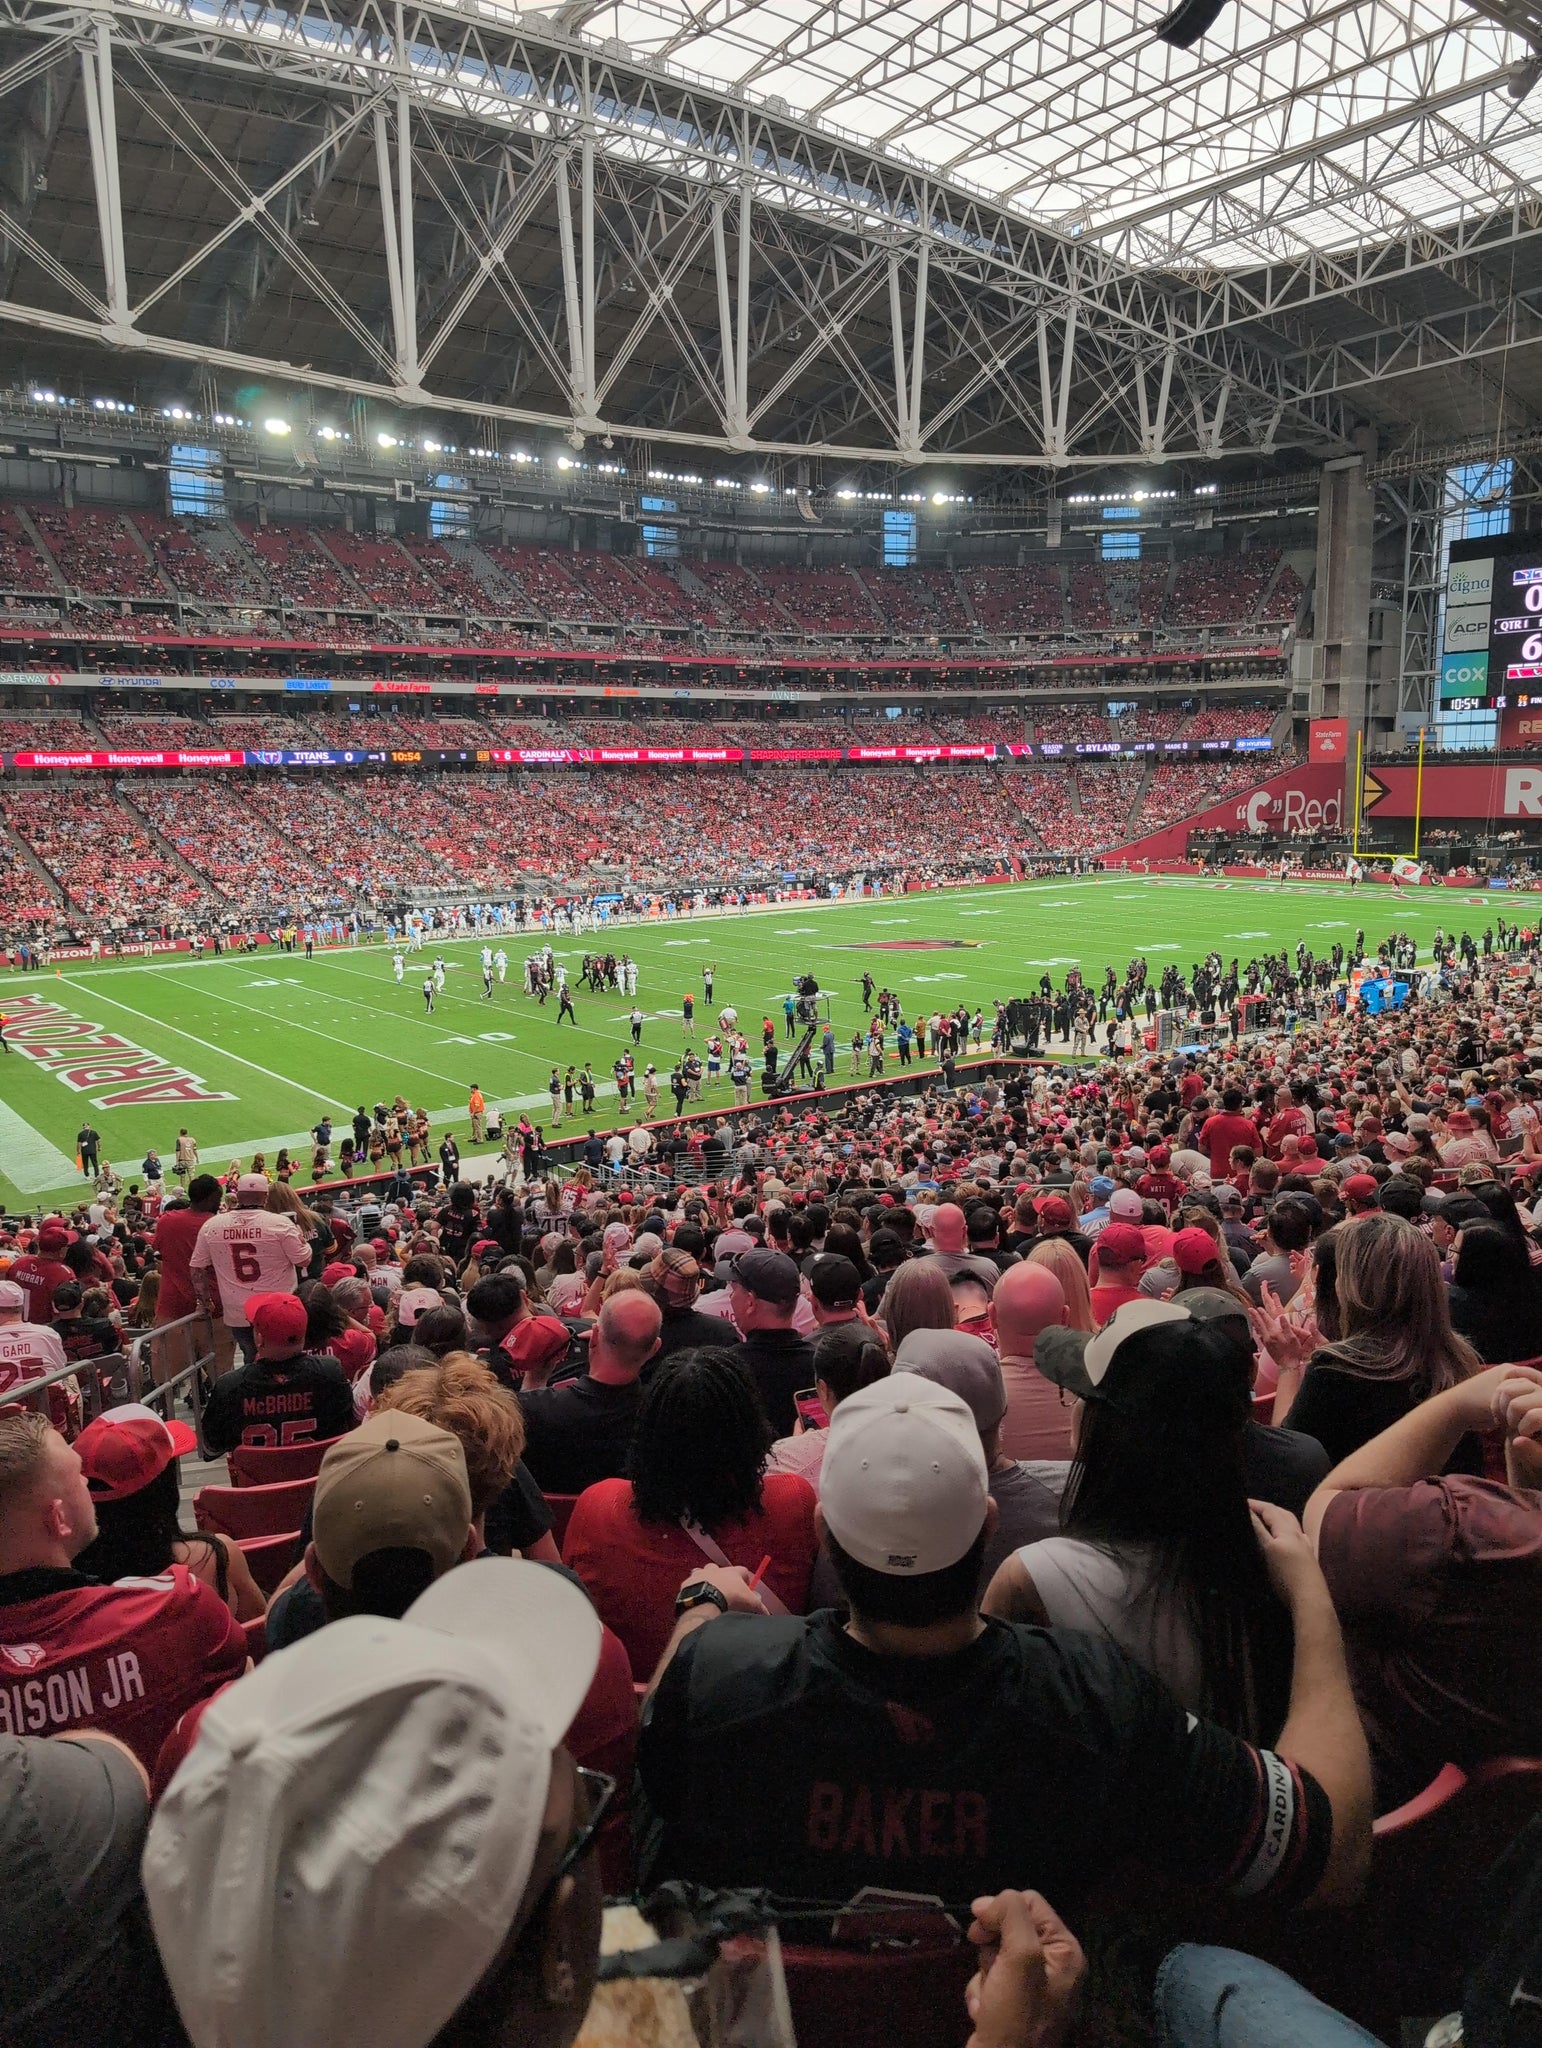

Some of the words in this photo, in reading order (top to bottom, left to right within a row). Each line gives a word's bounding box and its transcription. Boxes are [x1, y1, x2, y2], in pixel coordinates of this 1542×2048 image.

[1450, 578, 1490, 595] cigna
[1525, 584, 1542, 612] 0
[1454, 622, 1488, 633] ACP
[1501, 620, 1522, 631] QTR
[50, 632, 89, 641] WILLIAM
[90, 633, 100, 641] V.
[101, 634, 138, 642] BIDWILL
[1522, 633, 1542, 661] 6
[0, 674, 47, 684] SAFEWAY
[117, 677, 162, 686] HYUNDAI
[1445, 666, 1485, 684] COX
[210, 679, 236, 688] COX
[1451, 697, 1479, 710] 10:54
[860, 749, 897, 758] Honeywell
[905, 748, 942, 757] Honeywell
[950, 747, 986, 756] Honeywell
[1085, 744, 1121, 752] RYLAND
[34, 753, 93, 766] Honeywell
[108, 753, 164, 765] Honeywell
[178, 753, 231, 764] Honeywell
[293, 752, 330, 760] TITANS
[344, 752, 353, 762] 0
[391, 752, 422, 762] 10:54
[504, 751, 512, 760] 6
[519, 750, 566, 759] CARDINALS
[601, 751, 639, 761] Honeywell
[648, 751, 684, 760] Honeywell
[692, 751, 727, 760] Honeywell
[1284, 788, 1342, 833] Red
[562, 1188, 578, 1202] 85
[1150, 1185, 1166, 1193] WATT
[223, 1227, 262, 1240] CONNER
[229, 1242, 262, 1283] 6
[16, 1270, 45, 1286] MURRAY
[2, 1343, 31, 1358] GARD
[243, 1391, 314, 1417] McBRIDE
[101, 1650, 146, 1709] JR
[806, 1780, 988, 1859] BAKER
